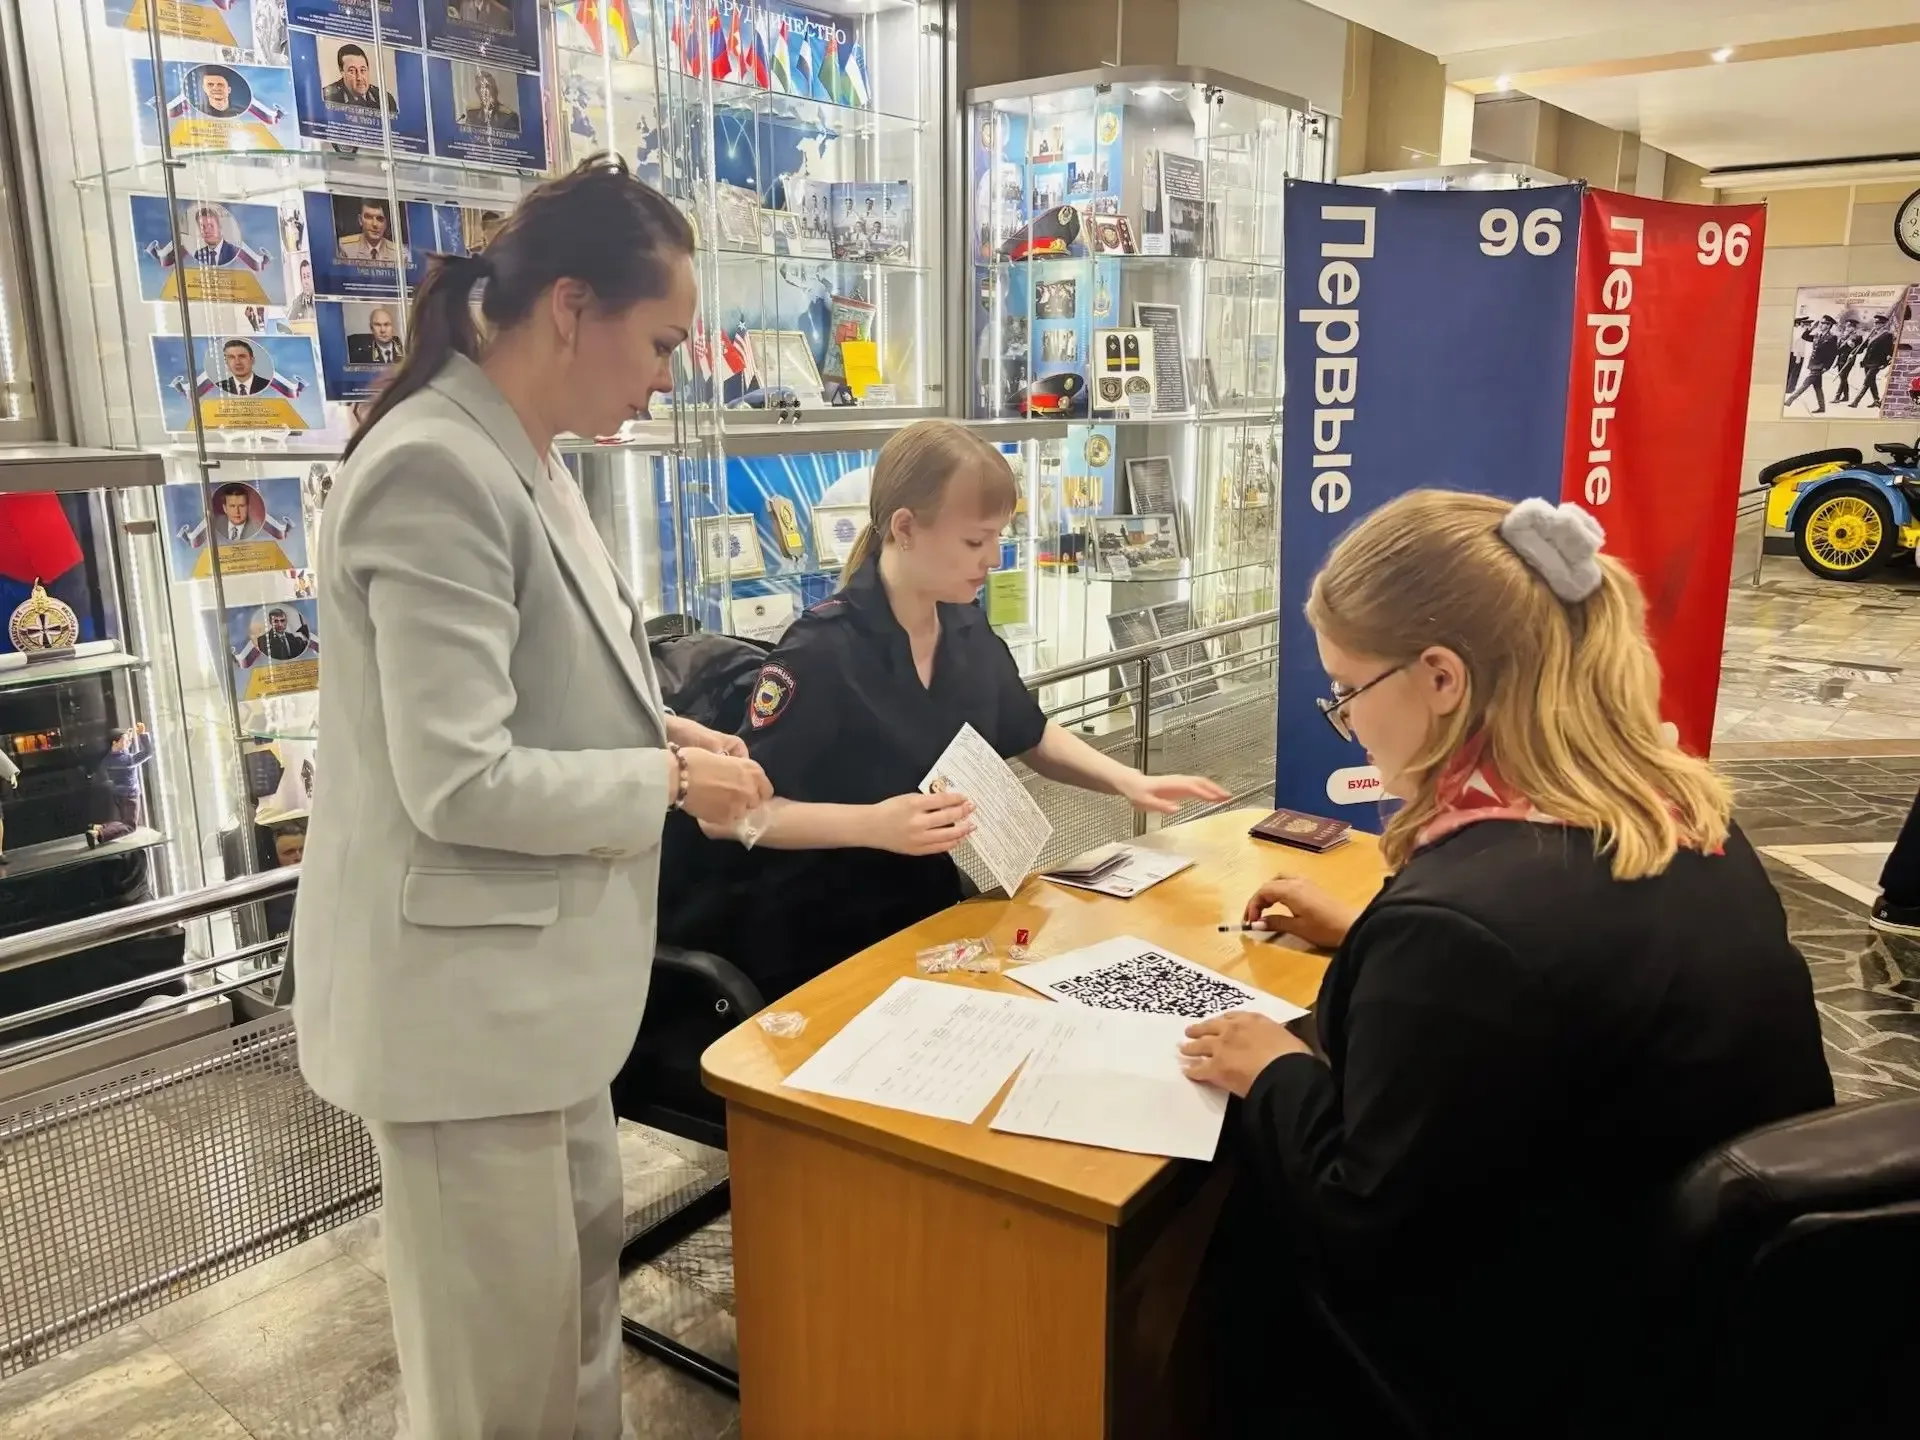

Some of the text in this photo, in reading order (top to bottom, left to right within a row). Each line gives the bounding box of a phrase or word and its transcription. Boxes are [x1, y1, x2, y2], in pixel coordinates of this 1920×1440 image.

[684, 0, 847, 45] РУДИЧЕСТВО
[1479, 207, 1563, 257] 96
[1697, 221, 1751, 267] 96
[1299, 205, 1377, 514] Первые
[1584, 215, 1644, 506] Первые
[1347, 778, 1380, 789] БУДЬ
